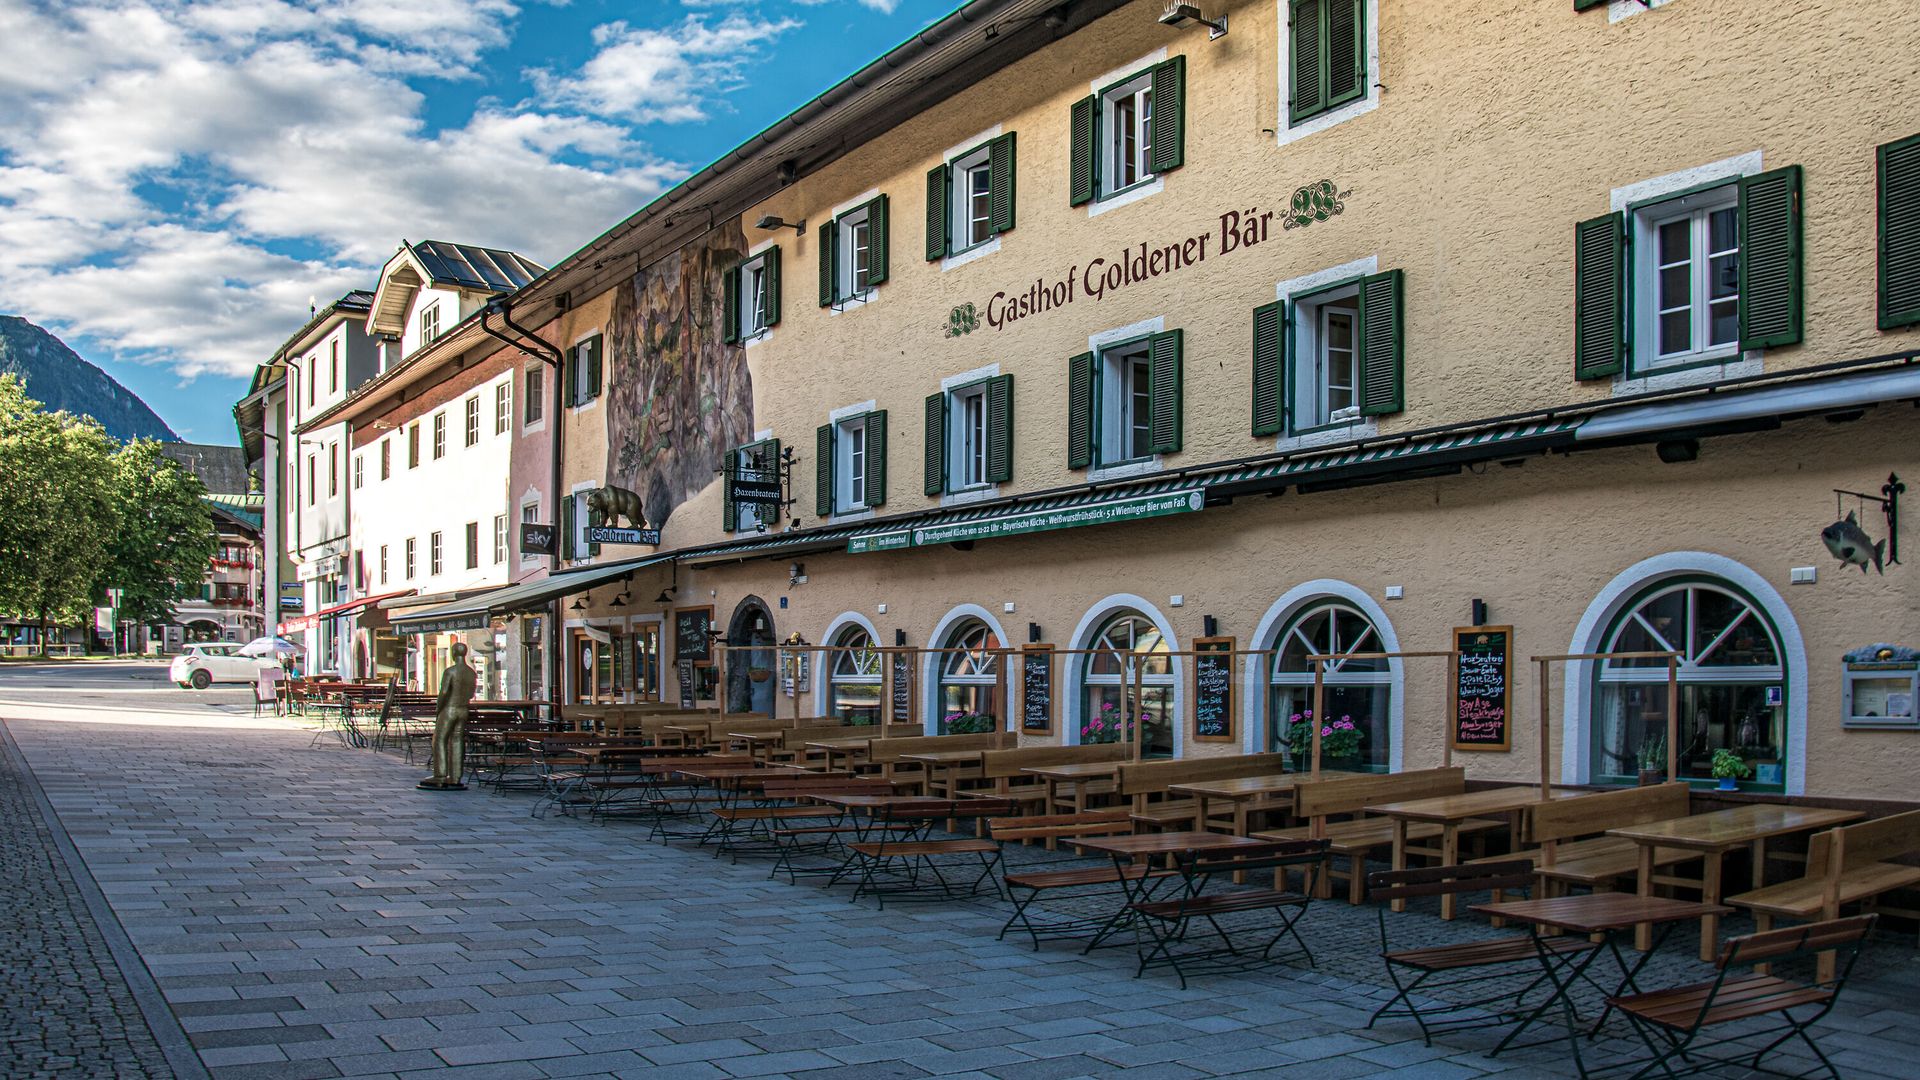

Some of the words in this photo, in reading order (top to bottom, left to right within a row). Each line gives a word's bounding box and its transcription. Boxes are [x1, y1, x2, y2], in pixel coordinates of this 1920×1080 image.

[987, 265, 1077, 331] Gasthof
[1083, 232, 1210, 301] Goldener
[1219, 207, 1273, 256] Bär
[734, 486, 780, 499] Haxenbraterei
[953, 528, 968, 538] Küche
[990, 523, 1000, 532] Uhr
[1002, 519, 1029, 532] Bayerische
[1029, 517, 1046, 528] Küche
[1106, 510, 1111, 519] 5
[1115, 504, 1147, 515] Wieninger
[1146, 502, 1159, 512] Bier
[1160, 500, 1173, 509] vom
[1173, 497, 1186, 507] Faß
[526, 528, 552, 548] sky
